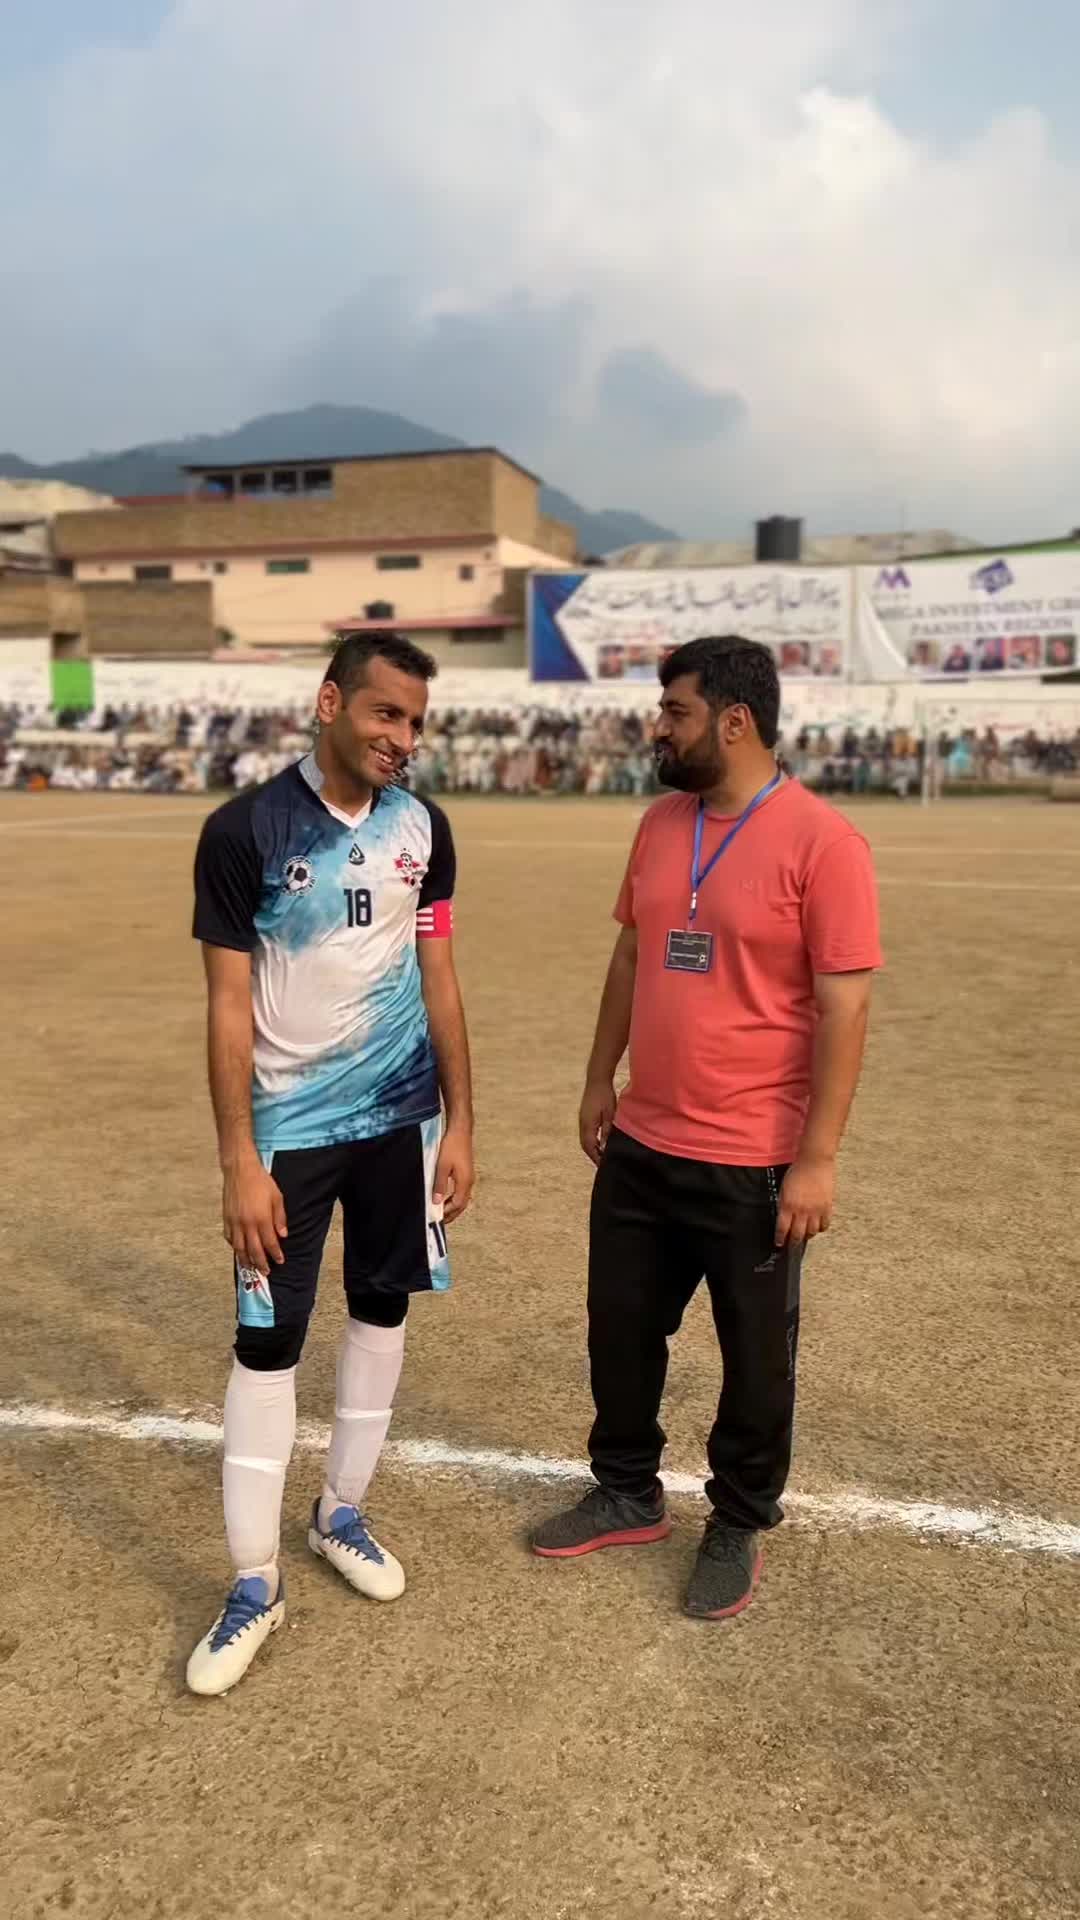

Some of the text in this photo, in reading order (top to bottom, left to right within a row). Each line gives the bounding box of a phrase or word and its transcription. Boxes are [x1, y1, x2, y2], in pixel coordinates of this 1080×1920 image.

[930, 600, 1043, 616] INVESTMENT
[911, 615, 1073, 636] PAKISTAN REGION
[343, 888, 372, 928] 18
